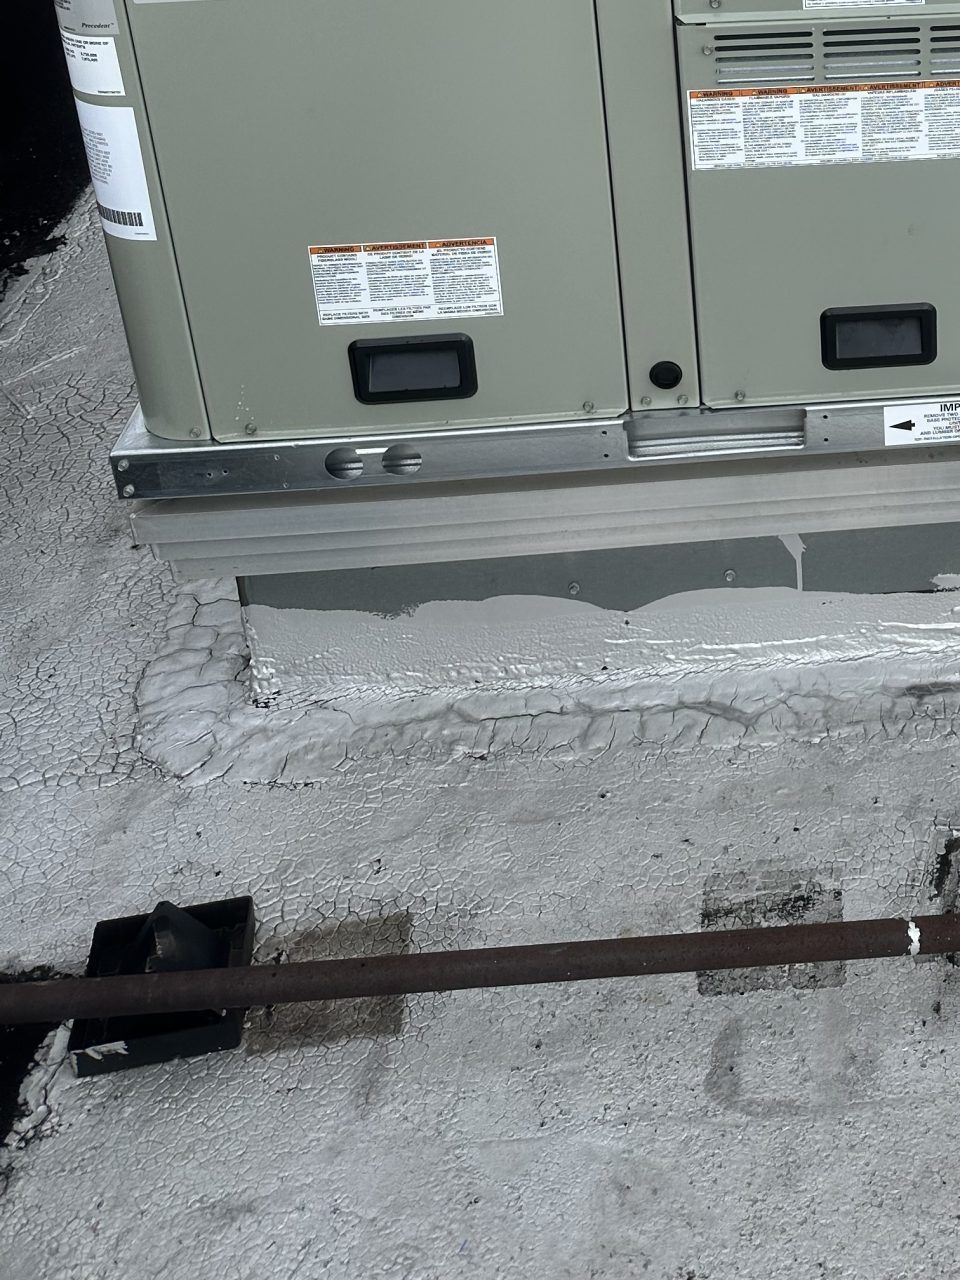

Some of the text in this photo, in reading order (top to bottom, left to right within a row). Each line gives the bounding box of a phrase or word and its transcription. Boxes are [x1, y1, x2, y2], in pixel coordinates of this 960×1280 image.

[806, 85, 858, 93] AVERTISSEMENT
[869, 82, 921, 90] AVERTISSEMENT
[702, 90, 734, 98] WARNING
[371, 243, 425, 251] AVERTISSEMENT
[442, 239, 488, 247] ADVERTENCIA
